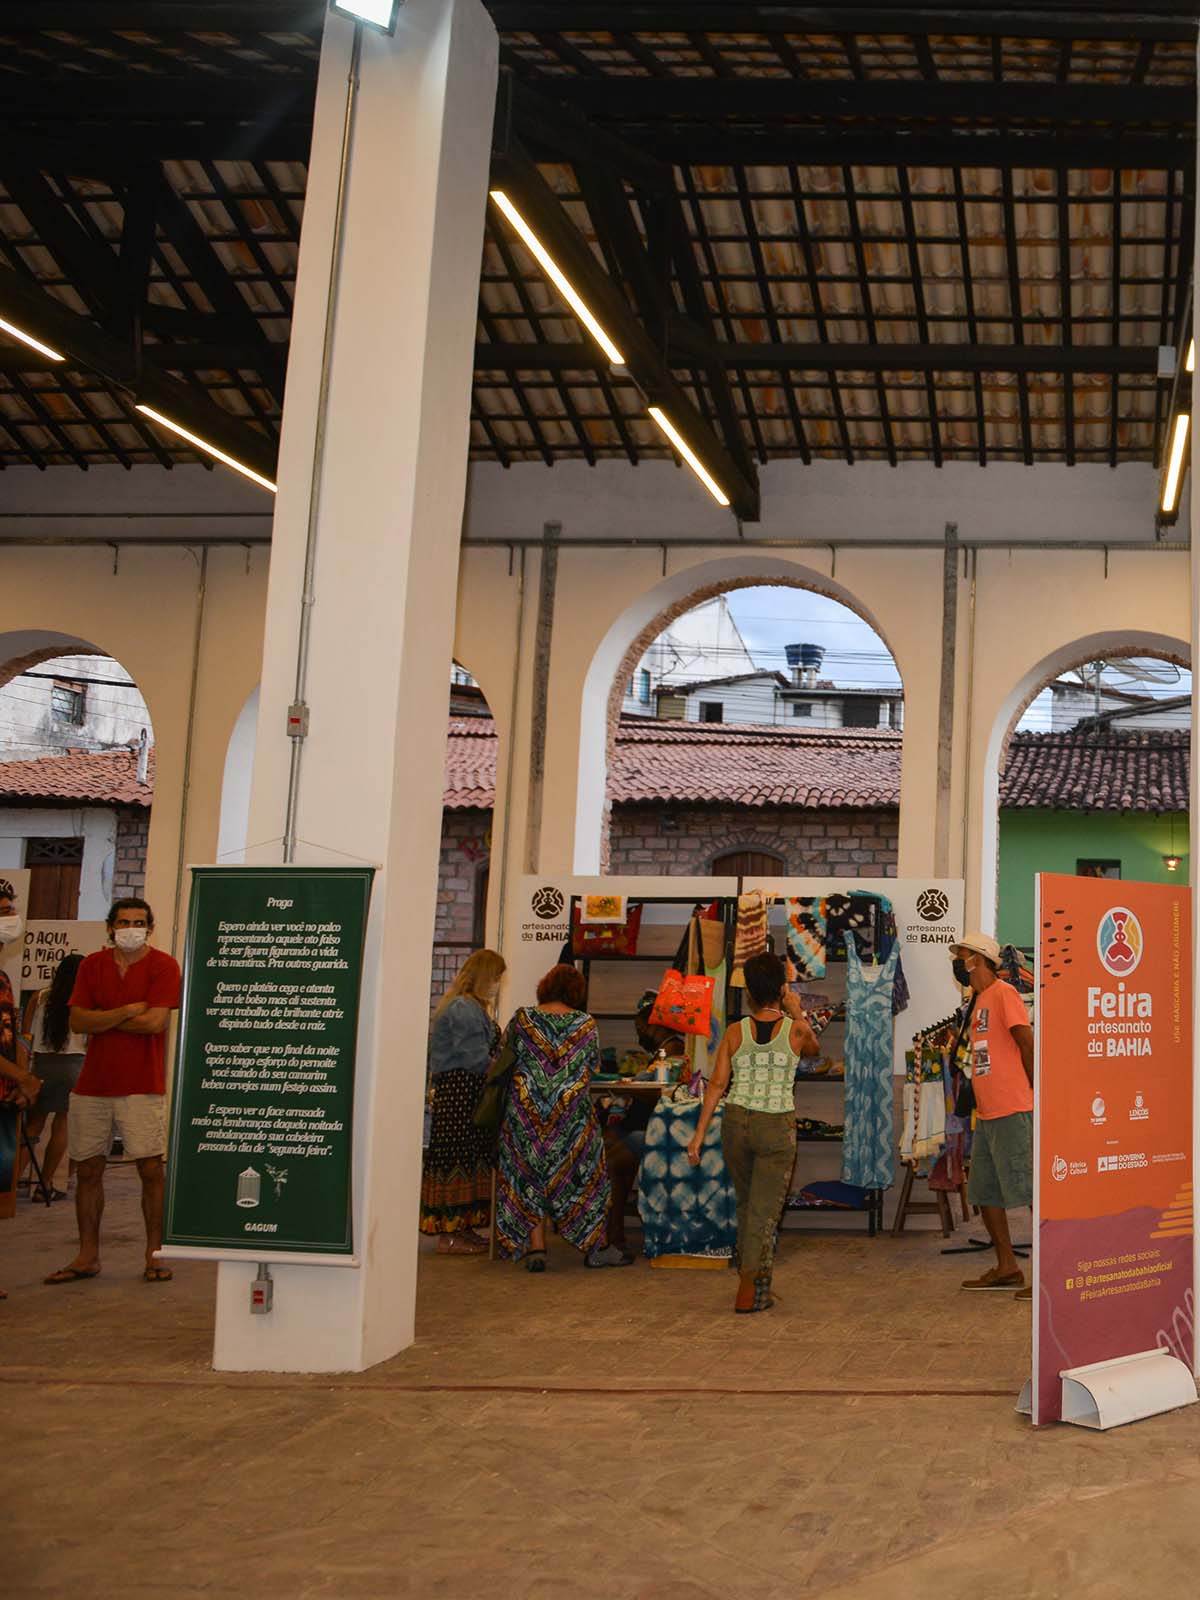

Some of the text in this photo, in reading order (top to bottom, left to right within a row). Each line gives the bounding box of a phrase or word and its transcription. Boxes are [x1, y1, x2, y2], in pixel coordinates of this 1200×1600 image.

[267, 897, 294, 909] Praga
[218, 921, 245, 933] Espero
[247, 922, 269, 931] ainda
[271, 923, 285, 931] ver
[287, 922, 304, 931] você
[318, 923, 341, 934] palco
[36, 931, 69, 946] AQUI,
[217, 934, 340, 946] representando aquele ato falso
[522, 932, 569, 942] da BAHIA
[906, 934, 956, 944] da BAHIA
[219, 946, 228, 955] de
[243, 946, 268, 957] figura
[269, 947, 310, 958] figurando
[319, 947, 338, 956] vida
[207, 958, 217, 966] de
[218, 959, 228, 967] vis
[268, 959, 284, 968] Pra
[286, 960, 311, 968] outros
[216, 982, 241, 994] Quero
[279, 985, 298, 995] cega
[306, 984, 335, 993] atenta
[213, 995, 233, 1004] dura
[234, 995, 243, 1004] de
[245, 995, 267, 1004] bolso
[268, 997, 287, 1005] mas
[300, 997, 336, 1005] sustenta
[1088, 982, 1152, 1018] Feira
[220, 1008, 233, 1016] seu
[234, 1007, 269, 1017] trabalho
[271, 1008, 282, 1017] de
[283, 1008, 321, 1018] brilhante
[322, 1009, 344, 1019] atriz
[253, 1020, 273, 1029] tudo
[275, 1020, 299, 1030] desde
[1088, 1020, 1152, 1034] artesanato
[205, 1042, 340, 1056] Quero saber que no final da noite
[1088, 1038, 1152, 1057] da BAHIA
[232, 1056, 255, 1067] longo
[288, 1057, 300, 1066] do
[300, 1057, 337, 1069] pernoite
[212, 1068, 327, 1080] você saindo do seu camarim
[201, 1079, 225, 1089] bebeu
[260, 1083, 281, 1091] num
[281, 1082, 309, 1095] festejo
[208, 1104, 215, 1114] E
[216, 1106, 242, 1117] espero
[265, 1106, 285, 1118] face
[198, 1142, 237, 1152] pensando
[238, 1142, 252, 1152] dia
[253, 1143, 265, 1153] de
[1119, 1153, 1145, 1162] GOVERNO
[1119, 1160, 1148, 1170] DO ESTADO
[245, 1223, 277, 1232] GAGUM
[1093, 1257, 1116, 1268] nossas
[1119, 1254, 1136, 1263] redes
